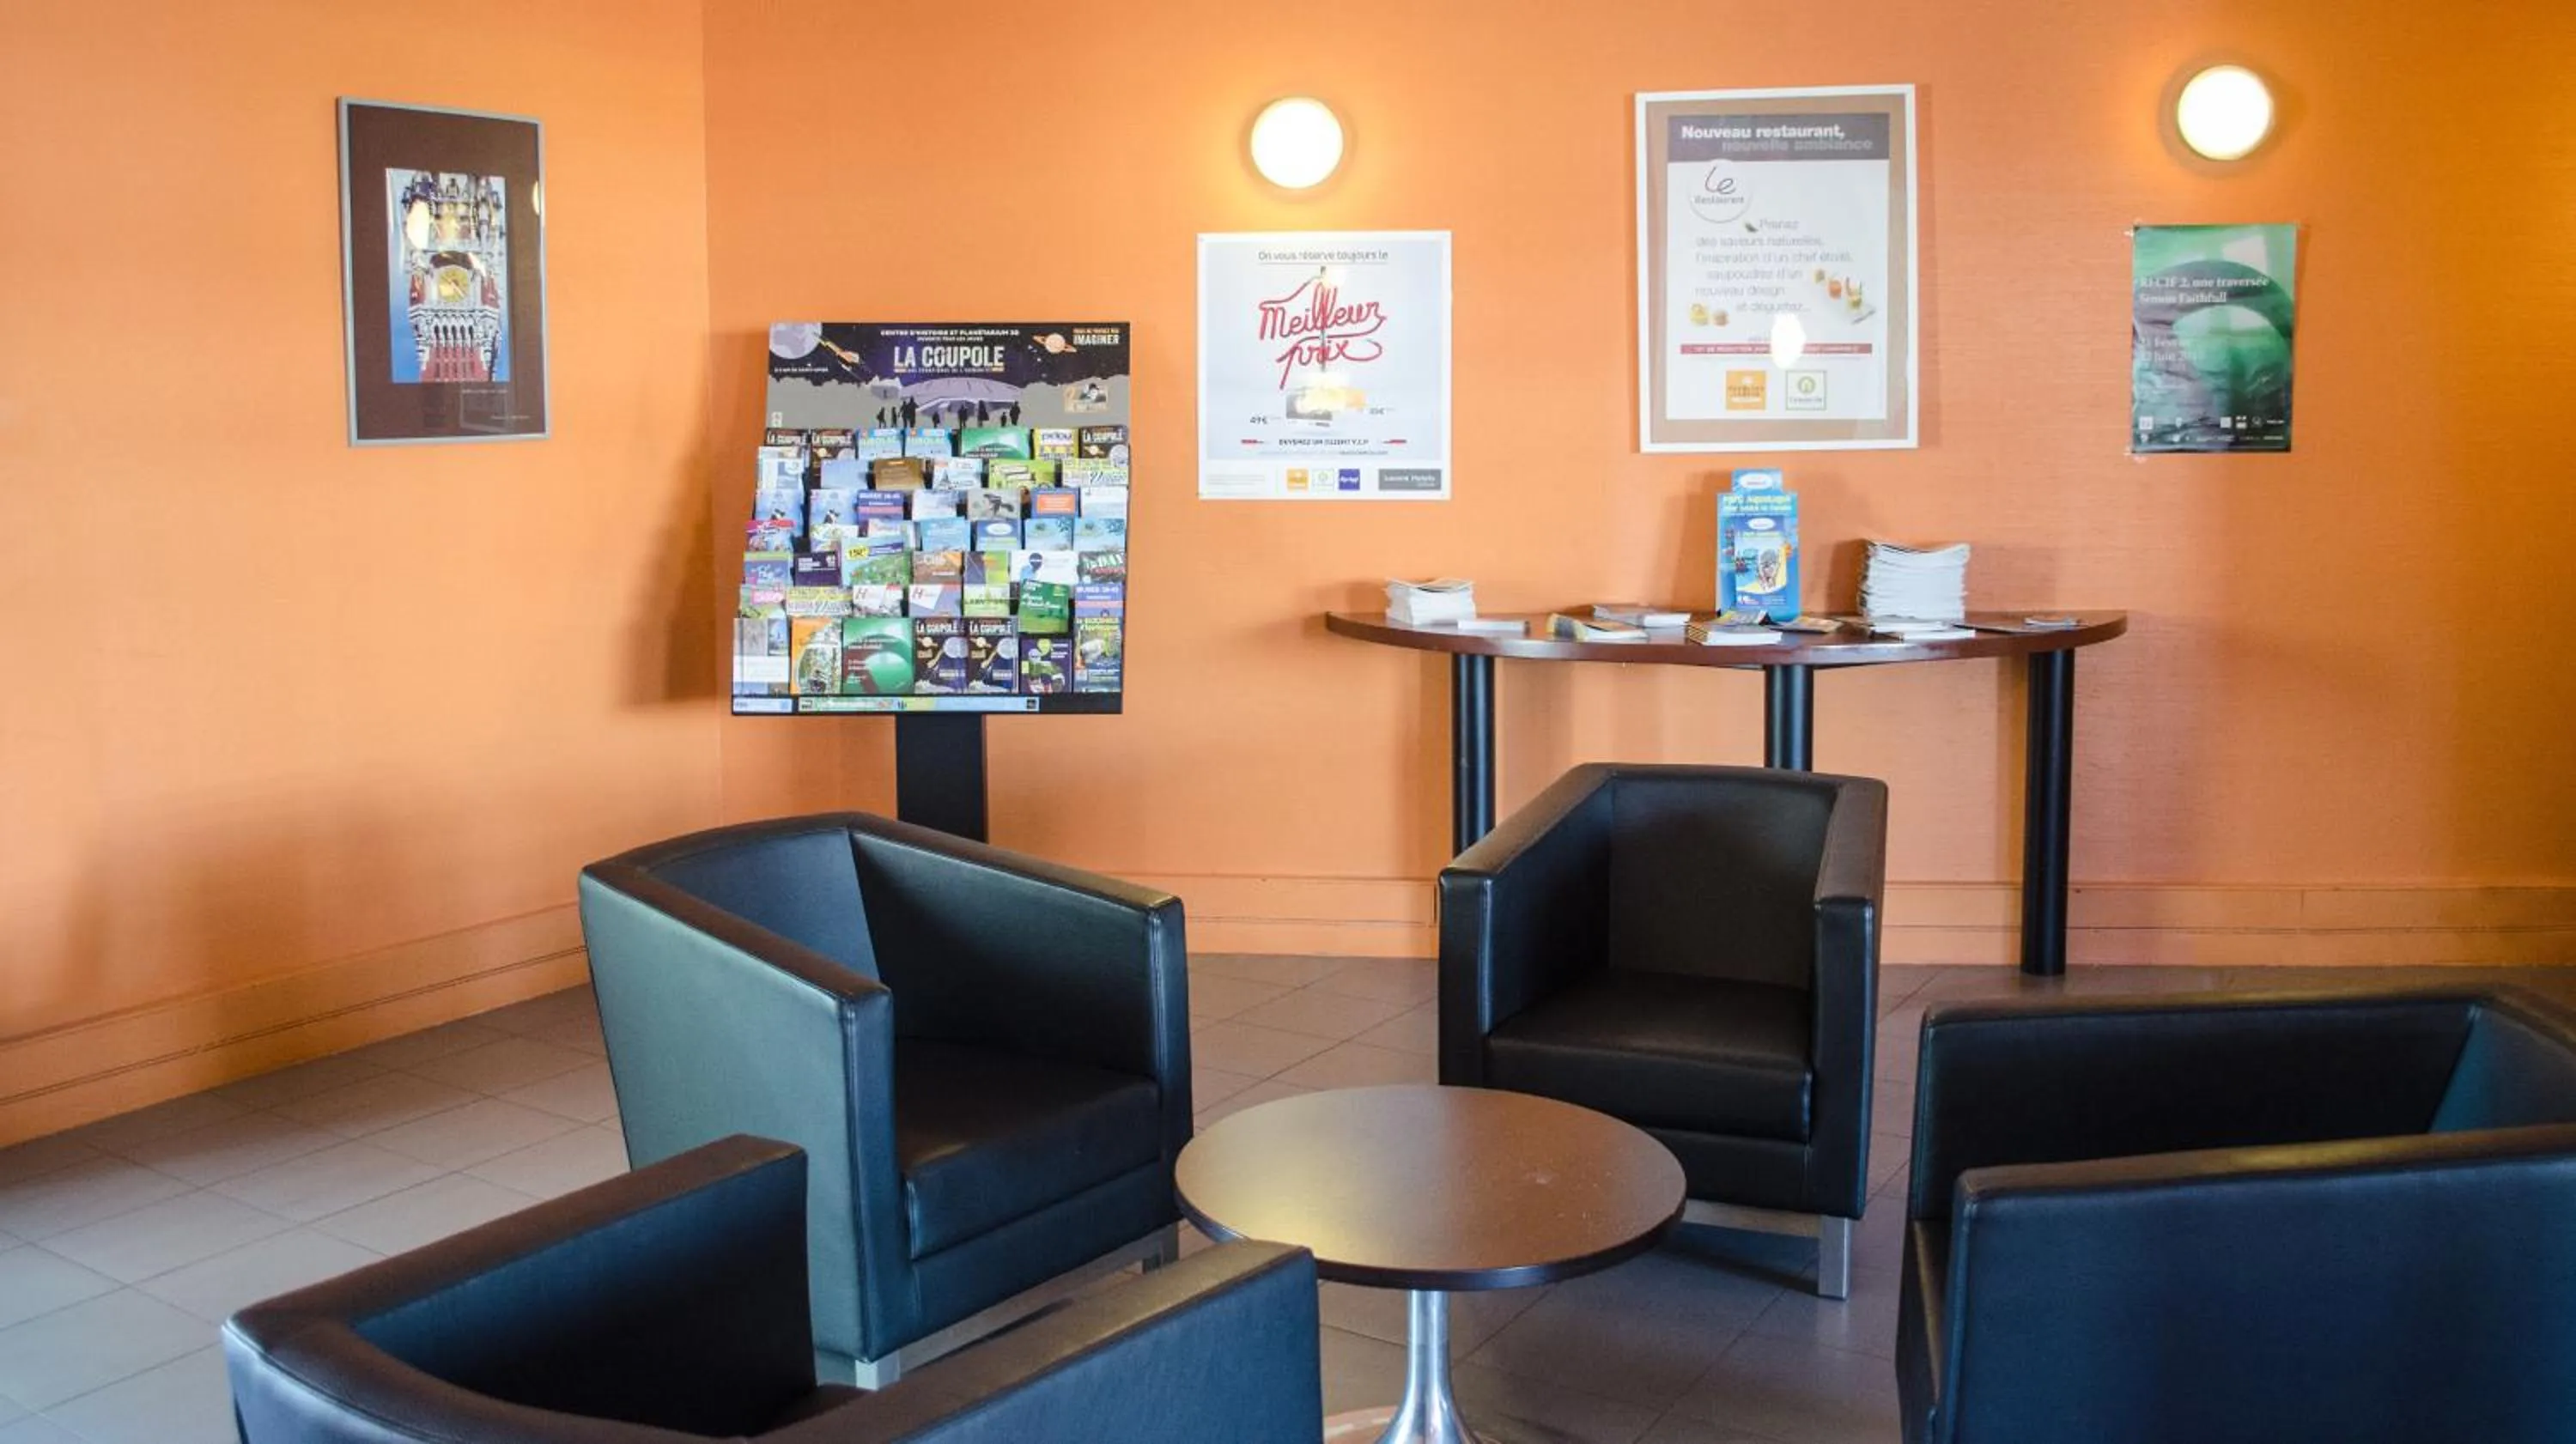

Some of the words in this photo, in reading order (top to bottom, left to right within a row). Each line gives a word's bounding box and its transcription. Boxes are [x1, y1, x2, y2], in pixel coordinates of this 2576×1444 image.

[1681, 125, 1751, 138] Nouveau
[1756, 124, 1845, 139] restaurant,
[1722, 139, 1789, 152] nouvelle
[1794, 138, 1873, 151] ambiance
[1694, 195, 1744, 204] Restaurant
[1258, 252, 1272, 260] On
[1337, 251, 1377, 262] toujours
[1379, 251, 1388, 259] le
[2192, 279, 2215, 288] une
[2178, 291, 2227, 303] Faithfull
[1259, 282, 1388, 340] Meilleur
[1073, 334, 1120, 345] IMAGINER
[894, 346, 916, 367] LA
[921, 346, 1005, 367] COUPOLE
[916, 620, 925, 634] LA
[927, 620, 958, 634] COUPOLE
[969, 620, 979, 634] LA
[981, 620, 1012, 634] COUPOLE
